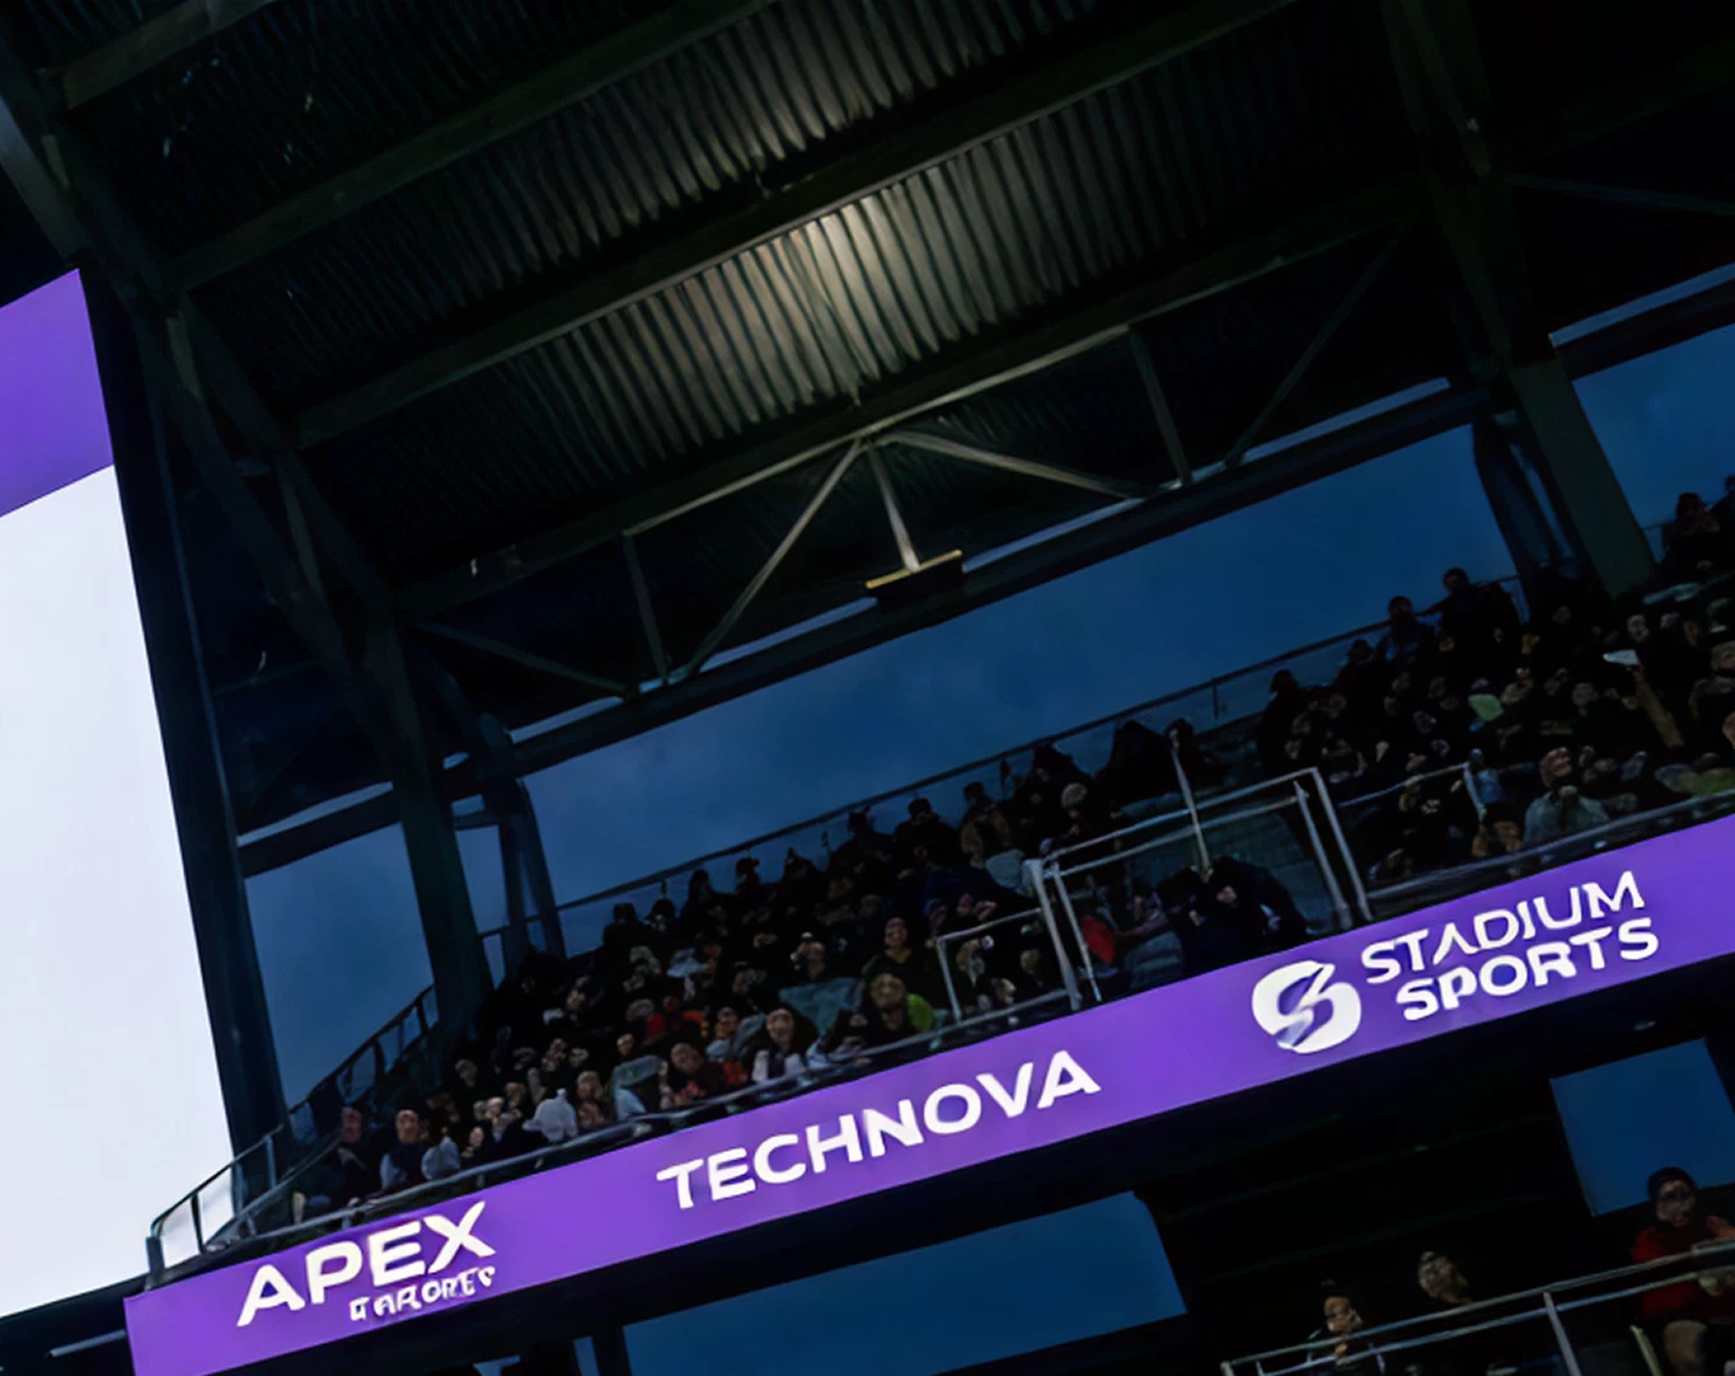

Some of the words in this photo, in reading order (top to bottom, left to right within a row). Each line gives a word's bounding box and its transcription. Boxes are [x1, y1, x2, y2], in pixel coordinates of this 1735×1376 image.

[1361, 870, 1645, 984] STADIUM
[1396, 917, 1659, 1021] SPORTS
[656, 1050, 1101, 1209] TECHNOVA
[236, 1201, 496, 1327] APEX
